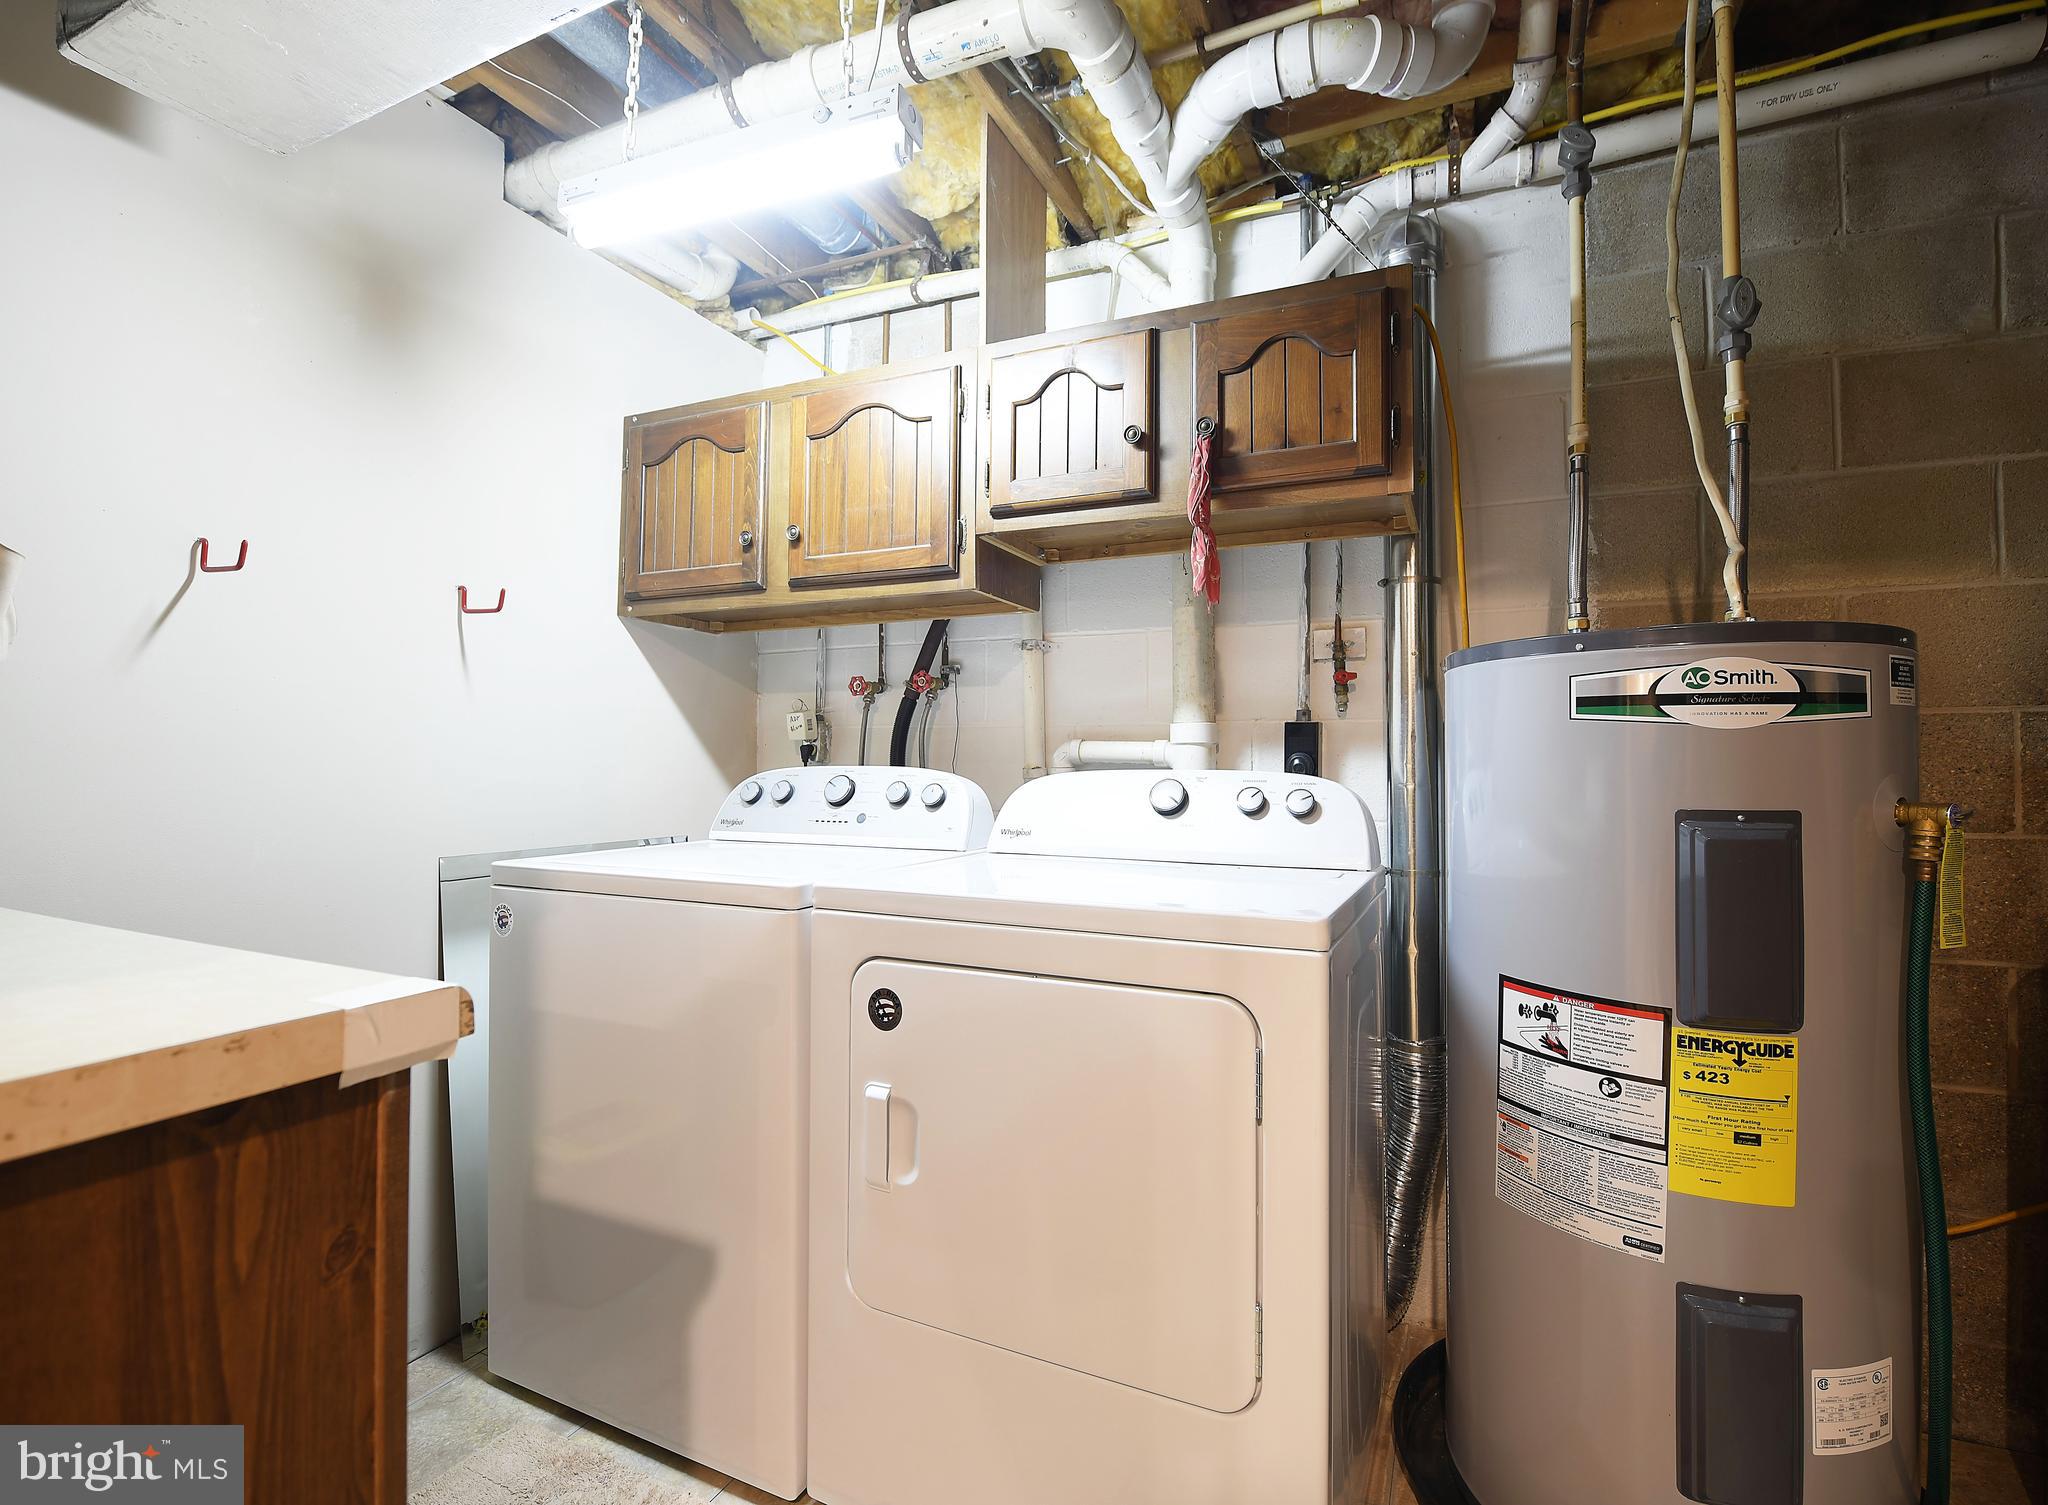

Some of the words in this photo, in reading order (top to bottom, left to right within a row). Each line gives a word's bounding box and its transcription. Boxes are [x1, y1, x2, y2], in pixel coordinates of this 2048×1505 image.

[1760, 98, 1778, 108] FOR
[1780, 92, 1798, 104] DWV
[1798, 88, 1814, 99] USE
[1816, 82, 1838, 94] ONLY
[1690, 694, 1737, 704] Signature
[720, 818, 744, 827] Whirlpool
[1000, 828, 1031, 839] Whirlpool
[1562, 997, 1594, 1009] DANGER
[1676, 1034, 1794, 1060] ENERGYGUIDE
[1683, 1070, 1691, 1080] $
[1696, 1070, 1730, 1084] 423
[1540, 1113, 1570, 1126] IMPORTANT
[1574, 1124, 1610, 1138] IMPORTANTE
